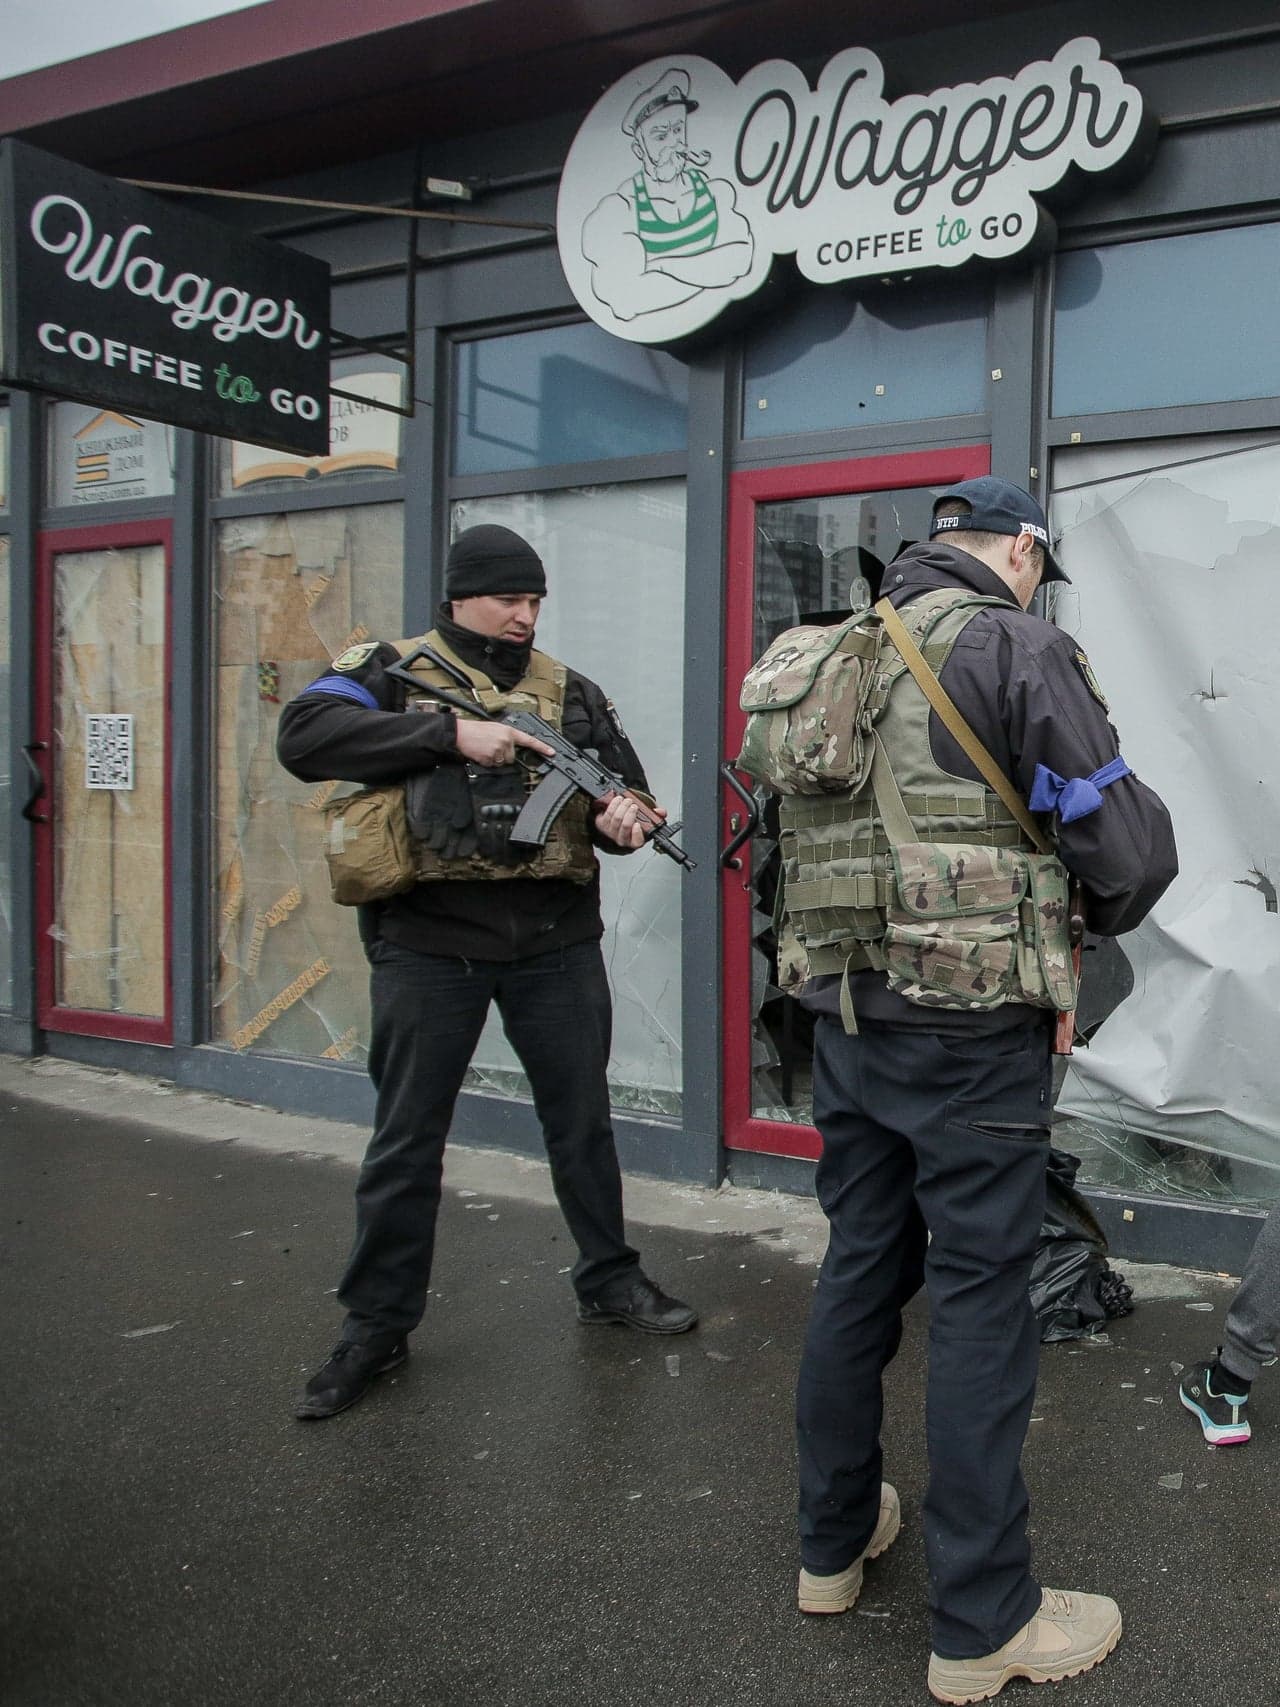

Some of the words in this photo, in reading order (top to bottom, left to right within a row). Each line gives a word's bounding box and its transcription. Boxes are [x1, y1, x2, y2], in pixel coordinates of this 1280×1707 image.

[734, 64, 1128, 215] Wagger
[30, 194, 321, 349] Wagger
[816, 227, 923, 266] COFFEE
[936, 214, 972, 248] to
[980, 213, 1023, 241] GO
[37, 322, 203, 391] COFFEE
[213, 362, 262, 404] to
[269, 388, 321, 421] GO
[936, 516, 959, 529] NYPD
